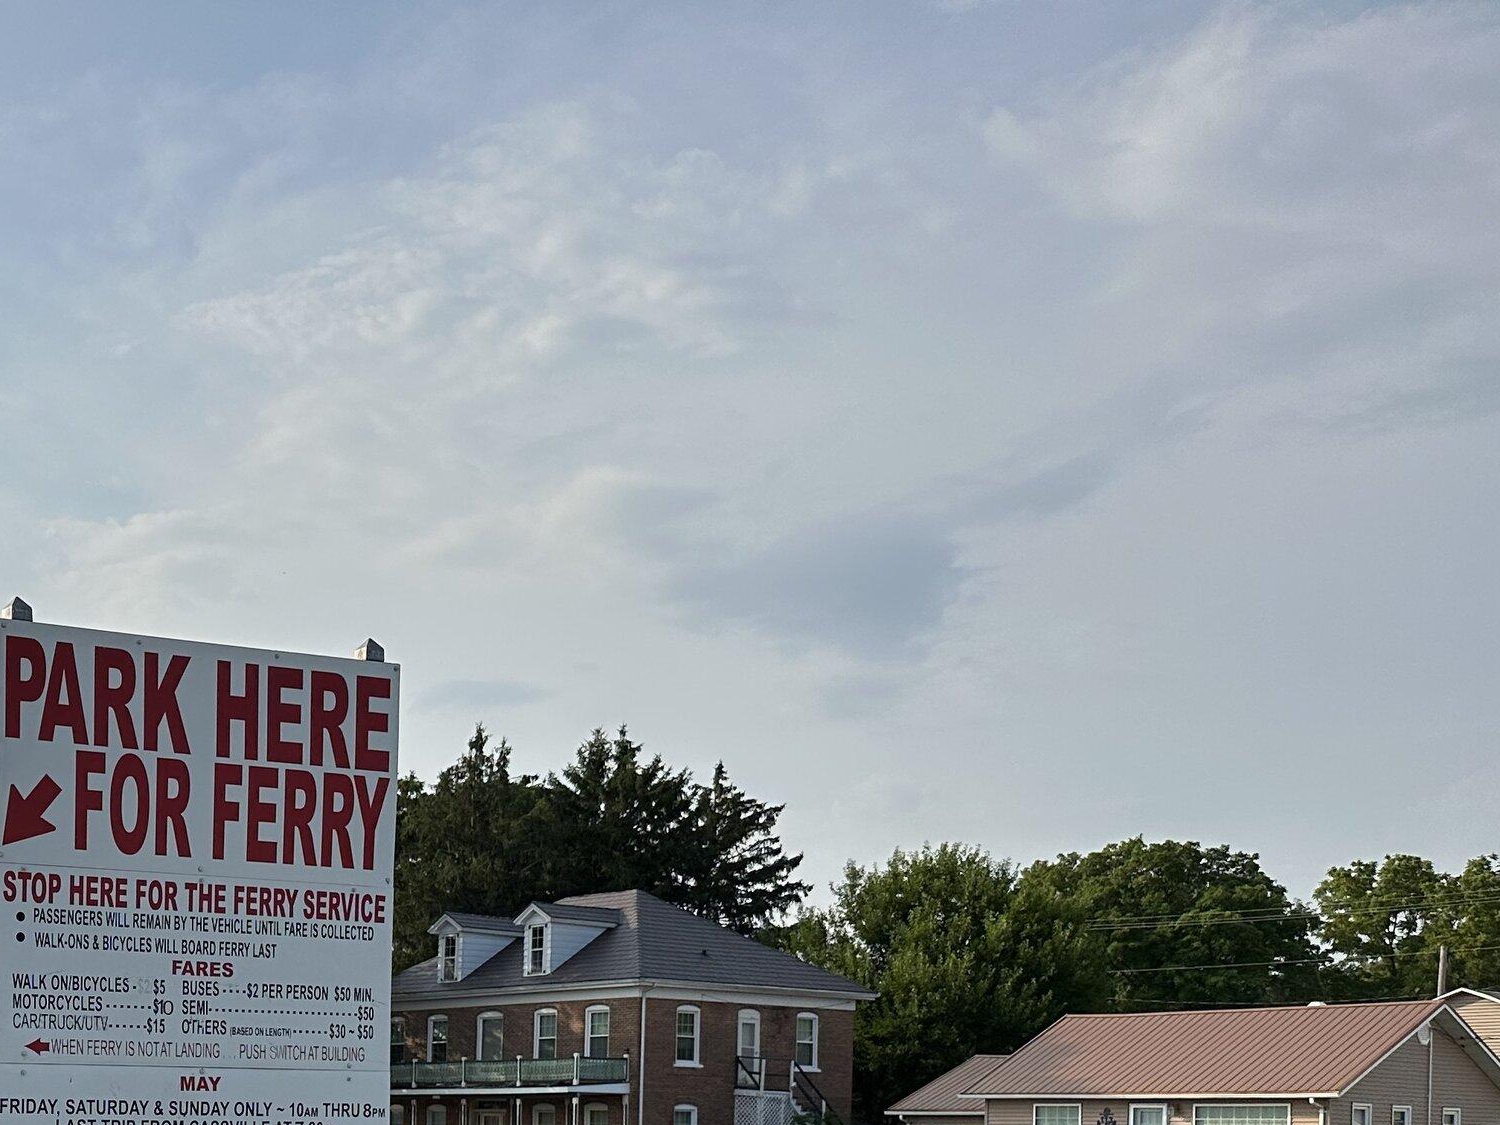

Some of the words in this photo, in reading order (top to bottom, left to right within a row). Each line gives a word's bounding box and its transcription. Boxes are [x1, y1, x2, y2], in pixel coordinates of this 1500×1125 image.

[5, 635, 191, 755] PARK
[216, 660, 391, 772] HERE
[74, 750, 191, 858] FOR
[212, 763, 390, 871] FERRY
[3, 871, 61, 904] STOP
[69, 875, 128, 908] HERE
[136, 879, 178, 911] FOR
[185, 882, 226, 914] THE
[233, 885, 298, 918] FERRY
[303, 889, 386, 923] SERVICE
[33, 908, 103, 926] PASSENGERS
[106, 912, 129, 928] WILL
[133, 914, 171, 929] REMAIN
[174, 916, 187, 930] BY
[191, 917, 208, 932] THE
[212, 918, 251, 934] VEHICLE
[255, 921, 281, 936] UNTIL
[285, 922, 307, 937] FARE
[310, 924, 318, 938] IS
[321, 924, 374, 941] COLLECTED
[35, 932, 89, 949] WALK-ONS
[93, 936, 99, 950] &
[103, 935, 152, 952] BICYCLES
[155, 938, 178, 954] WILL
[182, 940, 216, 955] BOARD
[219, 942, 250, 957] FERRY
[252, 943, 276, 959] LAST
[171, 960, 233, 978] FARES
[13, 973, 47, 989] WALK
[52, 975, 129, 993] ON/BICYCLES
[153, 979, 165, 995] $5
[182, 980, 219, 996] BUSES
[247, 983, 259, 998] $2
[262, 984, 283, 999] PER
[286, 985, 328, 1000] PERSON
[334, 987, 350, 1002] $50
[354, 988, 374, 1002] MIN.
[13, 994, 103, 1011] MOTORCYCLES
[153, 999, 173, 1015] $10
[182, 1000, 208, 1015] SEMI
[358, 1007, 374, 1021] $50
[13, 1013, 108, 1031] CAR/TRUCK/UTV
[147, 1018, 165, 1034] $15
[182, 1018, 227, 1035] OTHERS
[230, 1027, 253, 1037] (BASED
[254, 1028, 264, 1037] ON
[265, 1028, 292, 1037] LENGTH)
[329, 1024, 346, 1039] $30
[357, 1025, 374, 1040] $50
[51, 1039, 84, 1055] WHEN
[87, 1040, 122, 1056] FERRY
[126, 1041, 135, 1056] IS
[176, 1043, 220, 1059] LANDING
[239, 1044, 266, 1060] PUSH
[270, 1045, 306, 1061] SWITCH
[309, 1046, 319, 1060] AT
[322, 1046, 365, 1062] BUILDING
[180, 1076, 221, 1091] MAY
[0, 1098, 60, 1116] FRIDAY,
[66, 1099, 149, 1115] SATURDAY
[154, 1101, 163, 1116] &
[169, 1101, 229, 1117] SUNDAY
[234, 1102, 272, 1117] ONLY
[290, 1103, 318, 1117] 10AM
[323, 1103, 360, 1118] THRU
[363, 1104, 385, 1118] 8PM
